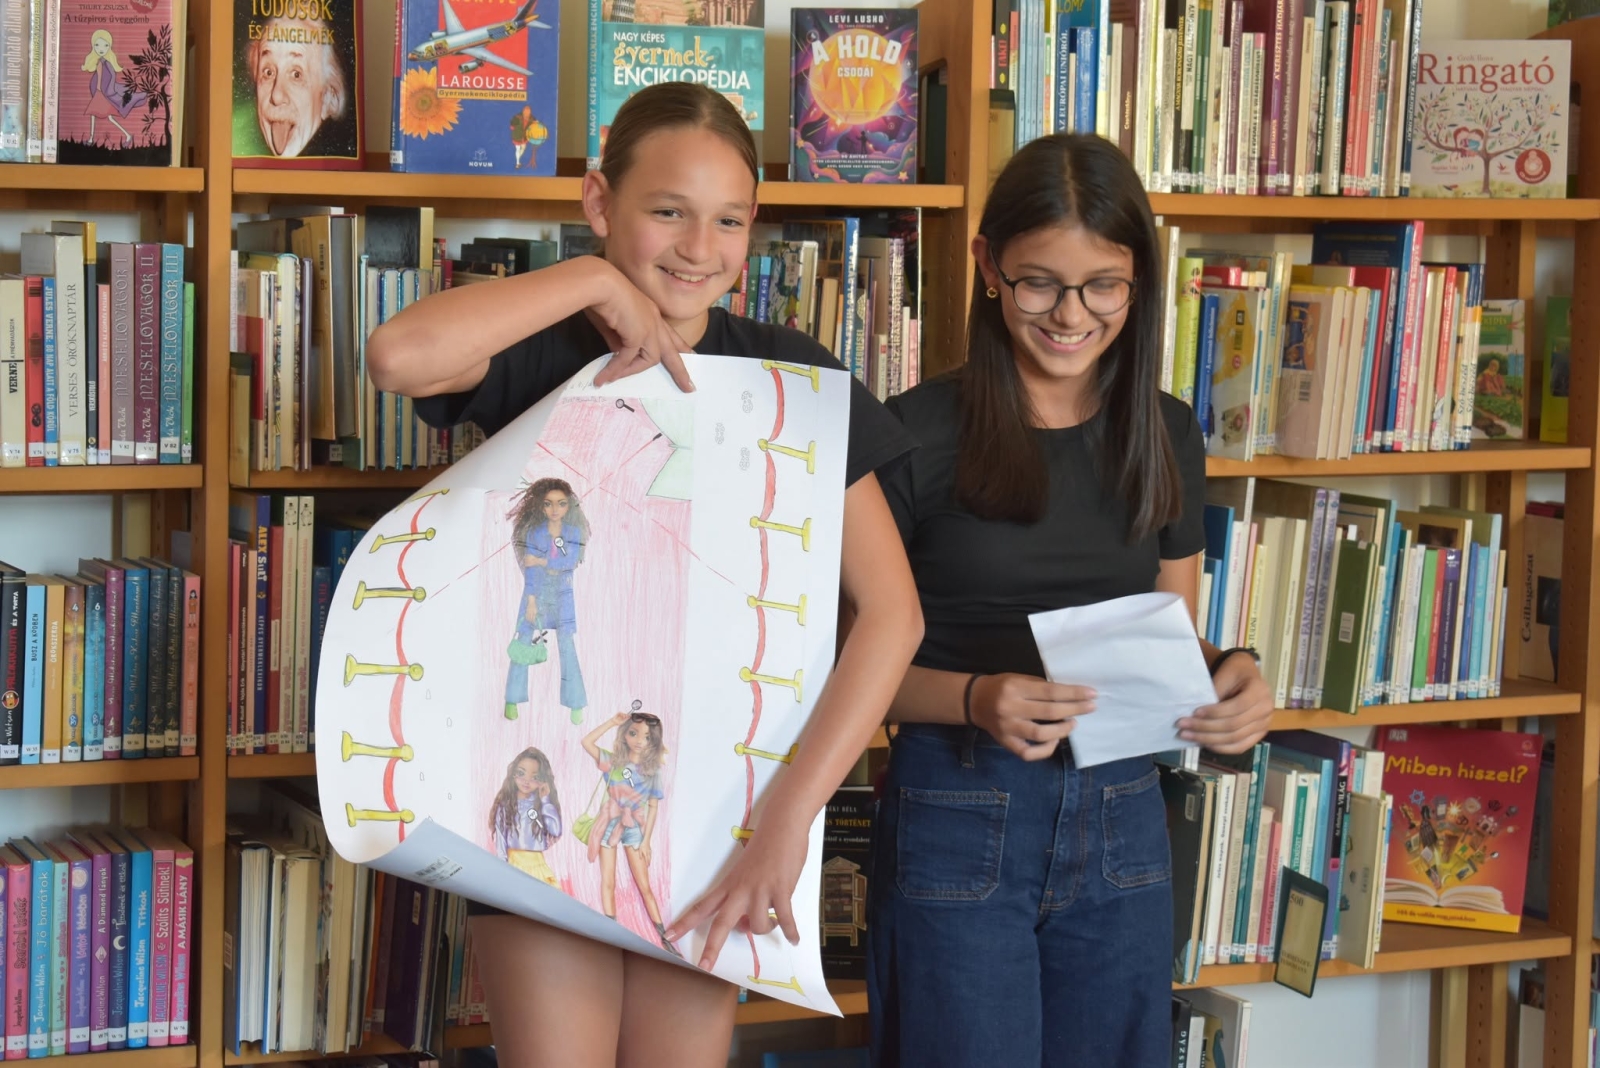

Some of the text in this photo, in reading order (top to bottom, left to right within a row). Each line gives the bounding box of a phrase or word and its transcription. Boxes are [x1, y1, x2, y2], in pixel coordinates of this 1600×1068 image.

[64, 14, 150, 25] A tűzpiros üveggömb
[829, 15, 850, 24] LEVI
[248, 21, 335, 45] ÉS LÁNGELMÉK
[613, 31, 665, 43] NAGY KÉPES
[613, 35, 715, 69] gyermek-
[811, 34, 902, 66] A HOLD
[1058, 29, 1068, 74] UNIÓRÓL
[1274, 32, 1282, 73] KERESZTES
[837, 66, 874, 78] CSODÁI
[1185, 54, 1194, 73] NAGY
[1417, 53, 1555, 94] Ringató
[438, 90, 525, 99] Gyermekenciklopédia
[441, 75, 525, 90] LAROUSSE
[589, 77, 597, 105] KÉPES
[1058, 76, 1068, 118] EURÓPAI
[589, 113, 597, 136] NAGY
[142, 253, 155, 269] II
[165, 251, 179, 274] III
[45, 286, 53, 311] JULES
[46, 344, 54, 352] 80
[46, 353, 54, 367] NAP
[66, 283, 79, 418] VERSES ÖRÖKNAPTÁR
[9, 362, 18, 394] VERNE
[47, 368, 55, 386] ALATT
[47, 393, 56, 409] FÖLD
[47, 411, 56, 432] KÖRÜL
[257, 526, 268, 554] ALEX
[72, 603, 79, 612] 4
[94, 602, 101, 611] 6
[1301, 582, 1315, 636] FANTASY
[1314, 583, 1328, 636] FANTASY
[11, 618, 18, 627] ÉS
[7, 628, 18, 690] PÁLCIKAKUTYA
[5, 709, 14, 737] Watson
[1385, 755, 1529, 784] Miben hiszel?
[1337, 781, 1346, 805] VILÁG
[99, 866, 108, 892] lányok
[158, 867, 171, 905] Sütinek!
[178, 875, 188, 905] LÁNY
[157, 907, 169, 939] Szólíts
[177, 906, 187, 940] MÁSIK
[34, 871, 49, 1022] Jacqueline Wilson Jó barátok
[135, 890, 147, 1008] Jacqueline Wilson Titkok
[179, 940, 186, 950] A
[113, 953, 124, 979] Wilson
[96, 975, 106, 997] Wilson
[113, 978, 125, 1016] Jacqueline
[156, 982, 167, 1023] JACQUELINE
